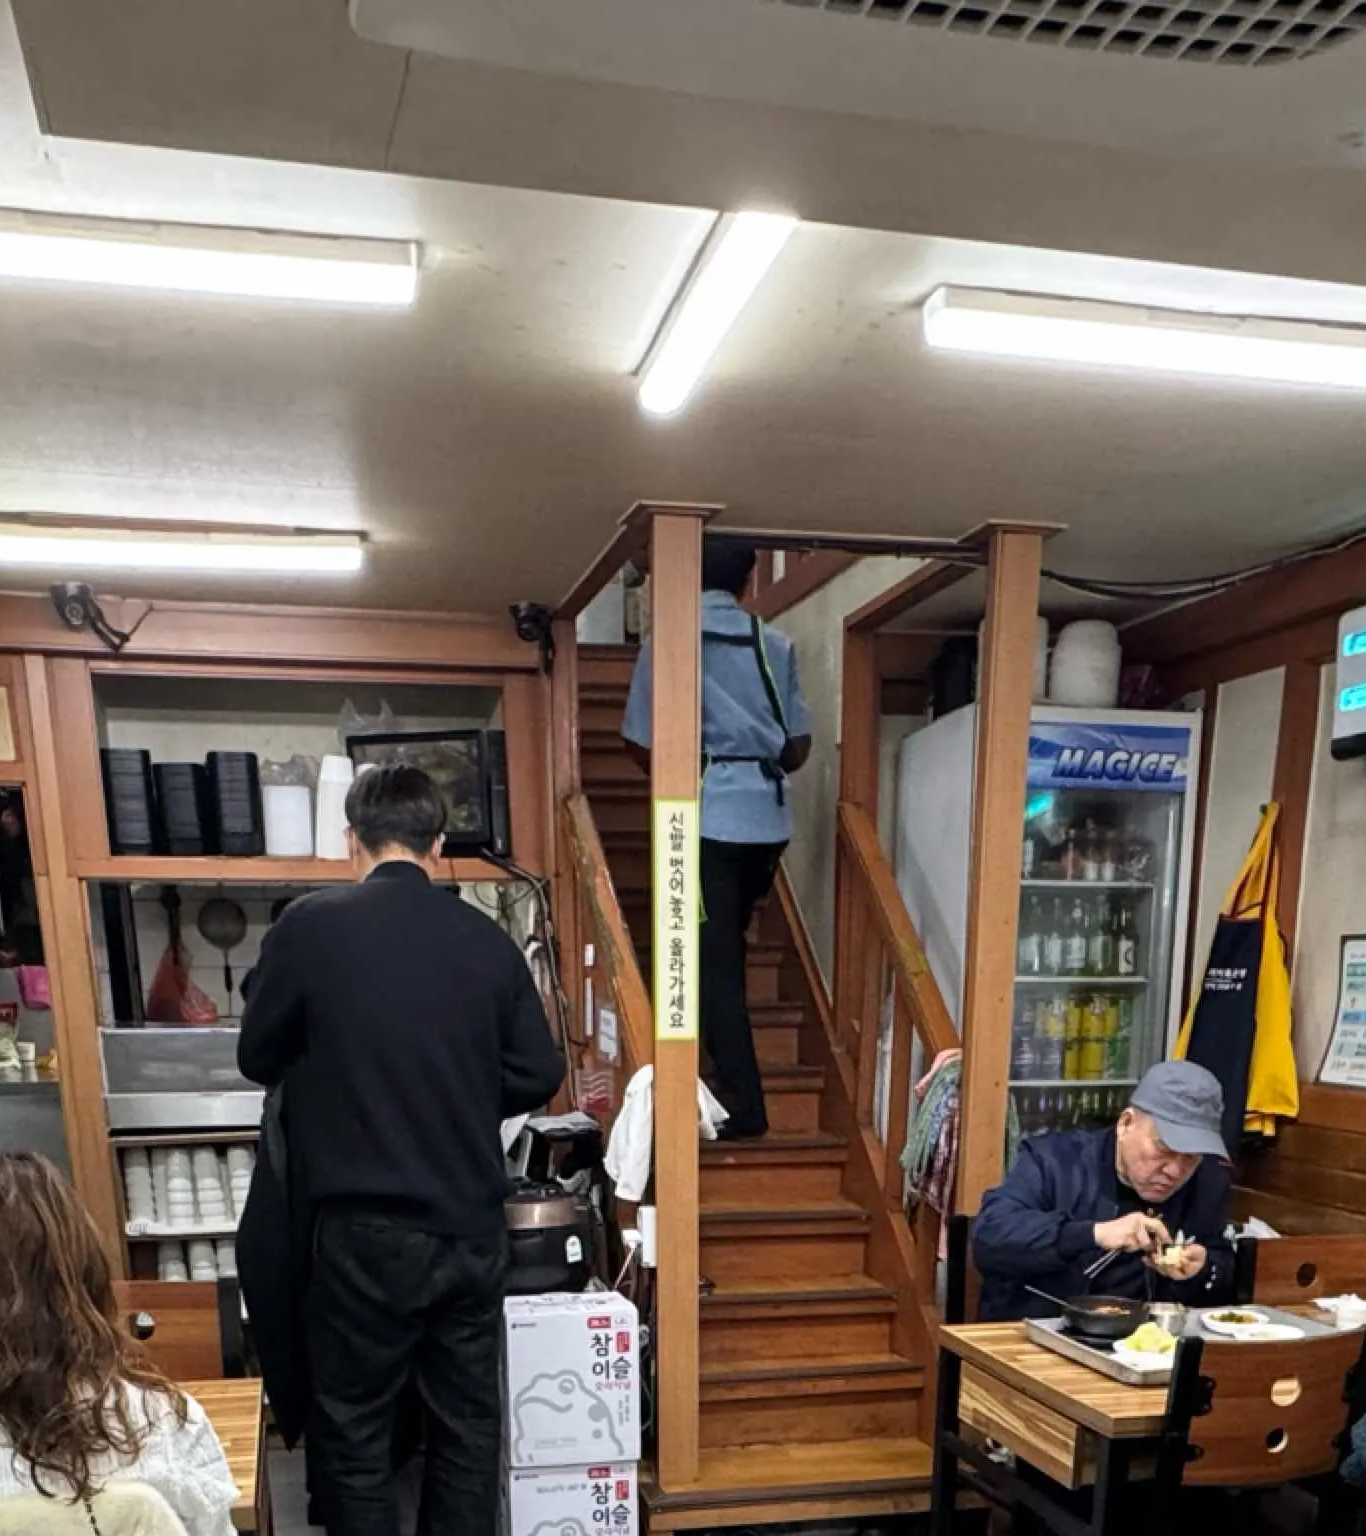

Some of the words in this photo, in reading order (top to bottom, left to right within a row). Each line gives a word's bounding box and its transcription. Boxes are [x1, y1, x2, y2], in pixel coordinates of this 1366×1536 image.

[668, 811, 684, 851] 신발
[668, 857, 685, 931] 벗어놓고
[668, 937, 685, 1029] 올라가세요
[590, 1332, 614, 1358] 참
[592, 1355, 632, 1381] 이슬
[590, 1481, 614, 1505] 참
[592, 1503, 632, 1527] 이슬
